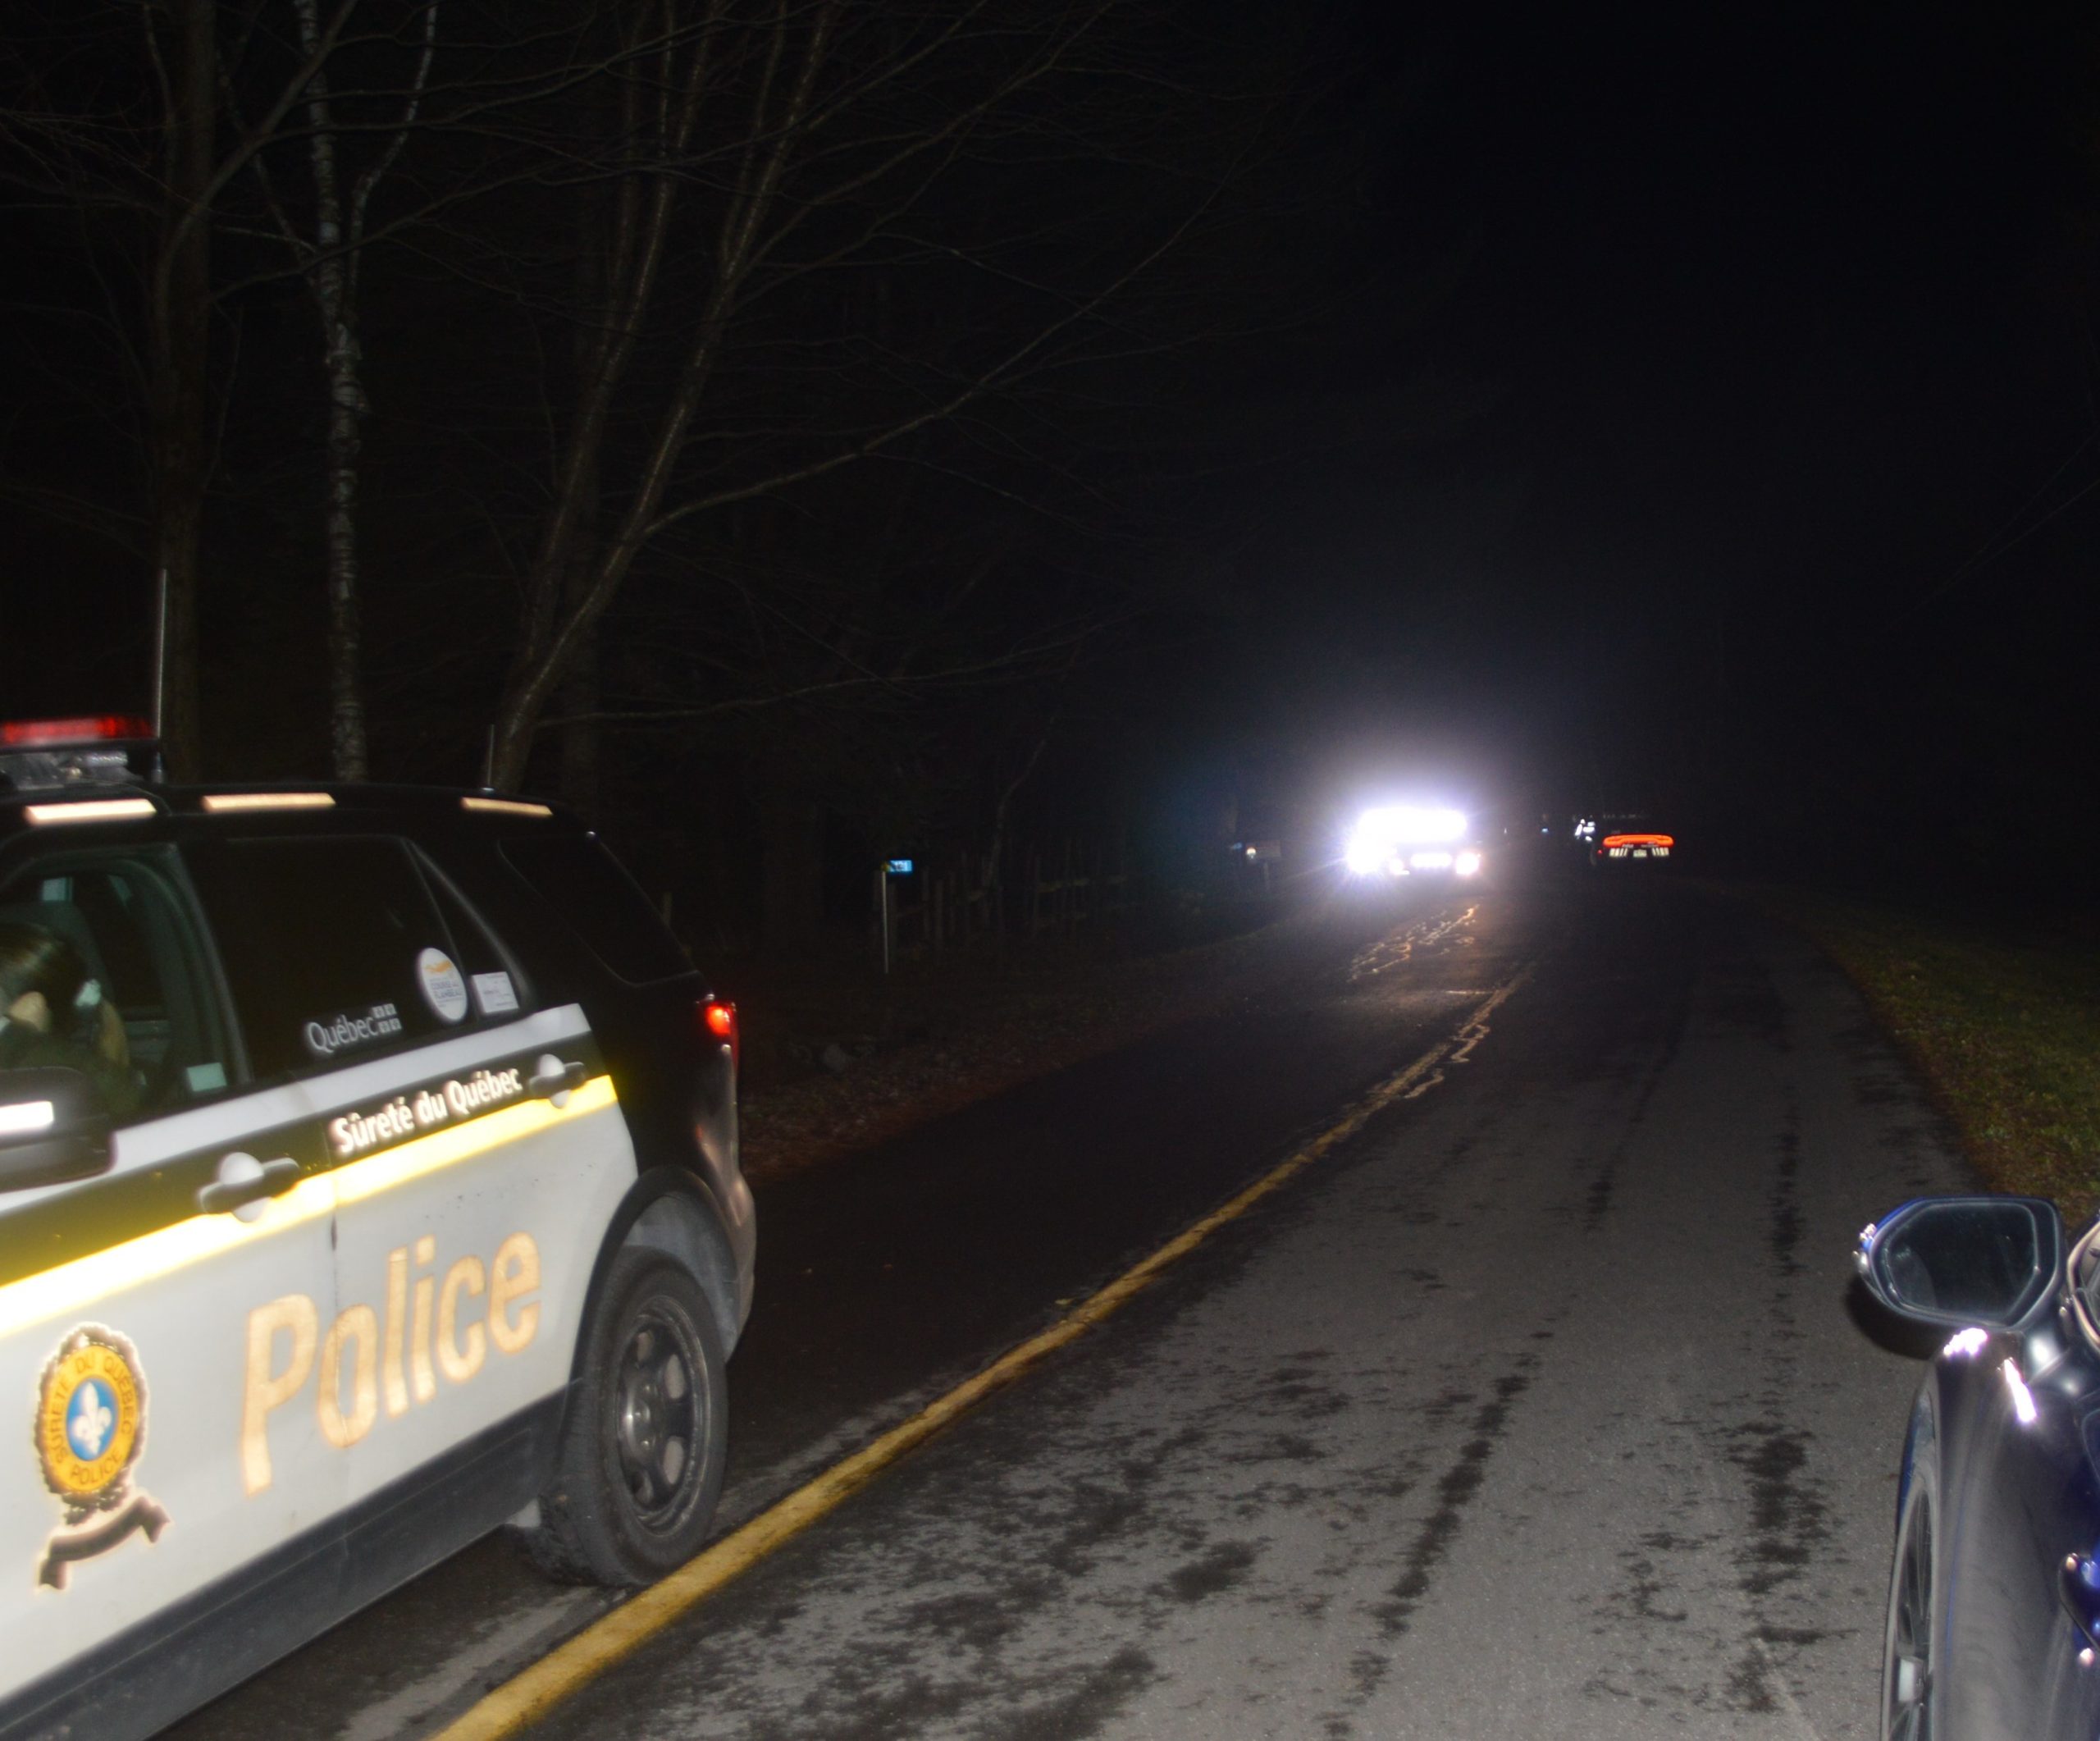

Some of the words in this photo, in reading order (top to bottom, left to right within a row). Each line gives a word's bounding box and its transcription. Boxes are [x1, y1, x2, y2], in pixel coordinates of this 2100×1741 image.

[308, 1013, 379, 1053] Québec
[331, 1095, 415, 1154] Sûreté
[413, 1090, 448, 1125] du
[444, 1067, 523, 1115] Québec
[75, 1351, 95, 1373] DU
[242, 1231, 541, 1498] Police
[71, 1449, 122, 1485] POLICE
